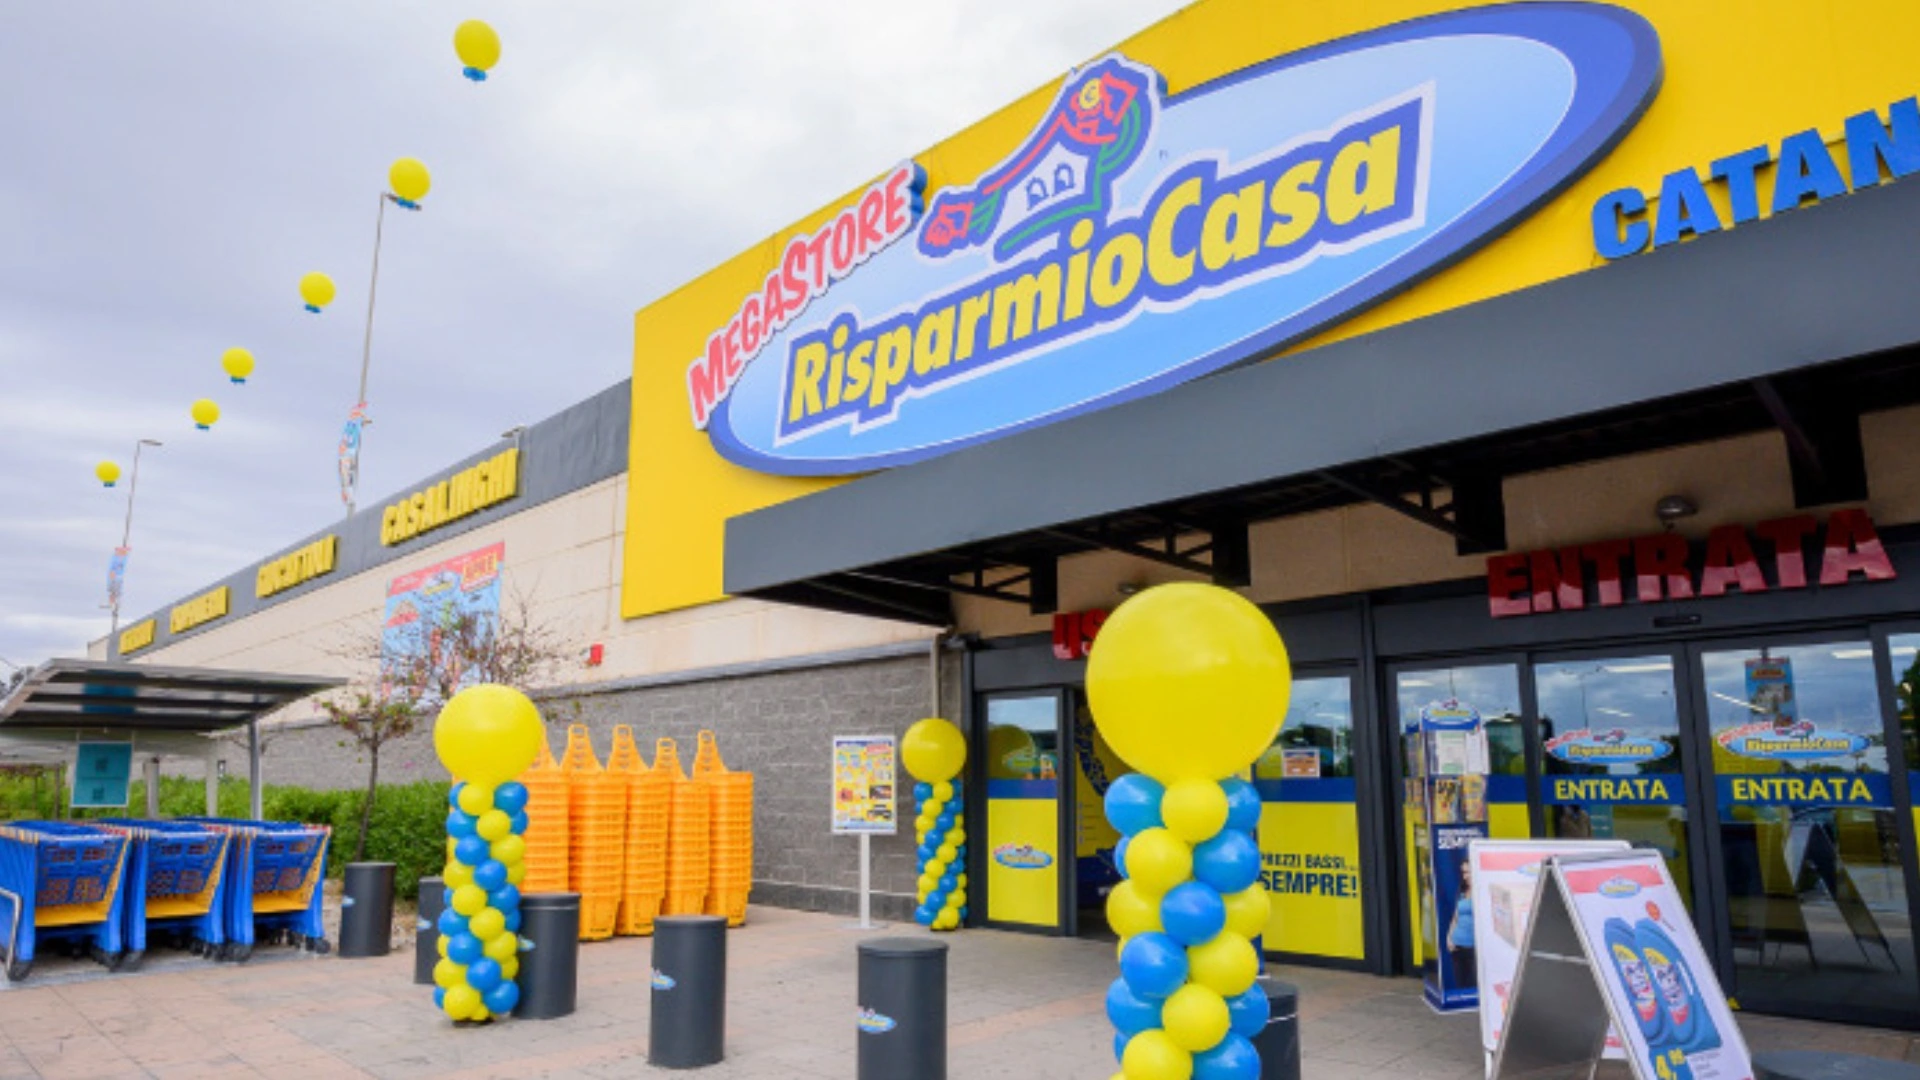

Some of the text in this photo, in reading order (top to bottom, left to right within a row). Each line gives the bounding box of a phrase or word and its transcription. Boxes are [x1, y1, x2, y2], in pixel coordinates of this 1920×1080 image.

[690, 168, 909, 422] MEGASTORE
[788, 124, 1401, 424] RisparmioCasa
[1487, 508, 1898, 618] ENTRATA
[1052, 608, 1107, 660] US
[1554, 779, 1669, 800] ENTRATA
[1732, 778, 1873, 801] ENTRATA
[1258, 871, 1359, 898] SEMPRE!
